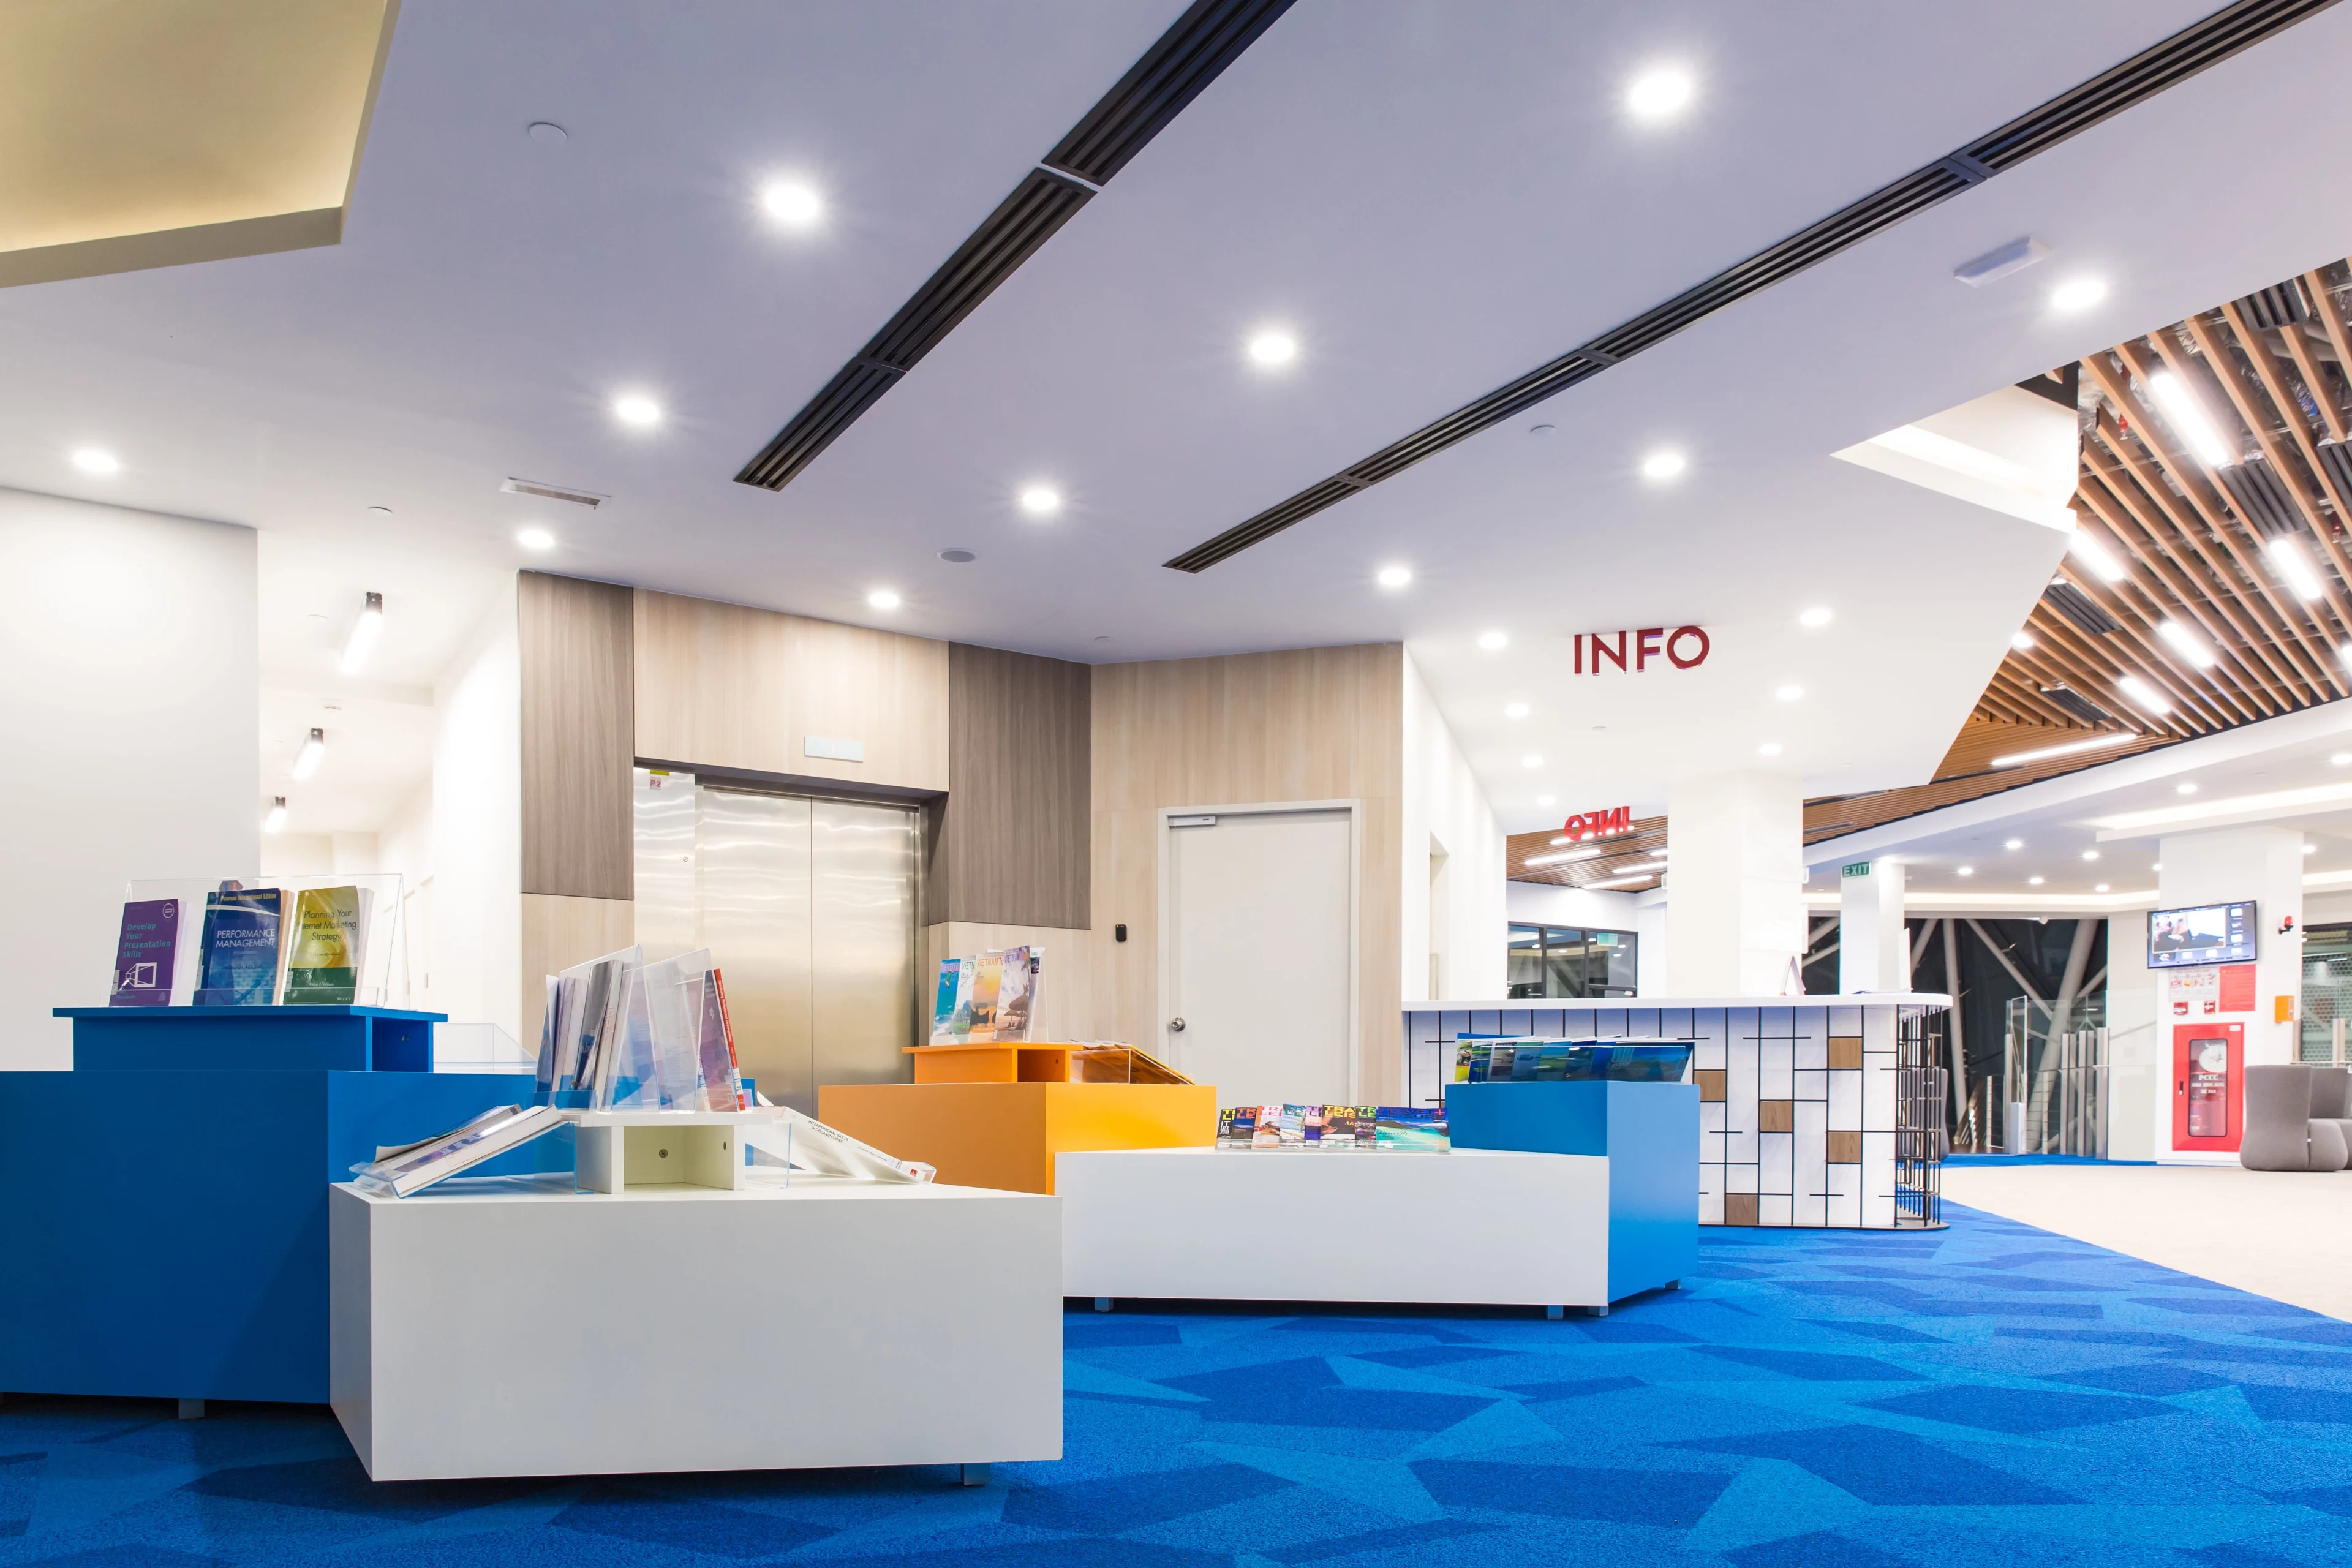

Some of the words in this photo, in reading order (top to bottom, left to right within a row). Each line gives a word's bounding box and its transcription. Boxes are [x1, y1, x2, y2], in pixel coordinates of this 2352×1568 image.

[1574, 625, 1710, 676] INFO
[650, 779, 661, 788] P2
[1844, 864, 1868, 876] EXIT
[304, 910, 334, 919] Planning
[217, 929, 275, 938] PERFORMANCE
[312, 932, 341, 942] Strategy
[216, 938, 274, 948] MANAGEMENT
[809, 1120, 836, 1136] INTERPERSONAL
[815, 1128, 843, 1143] ORGANIZATIONS
